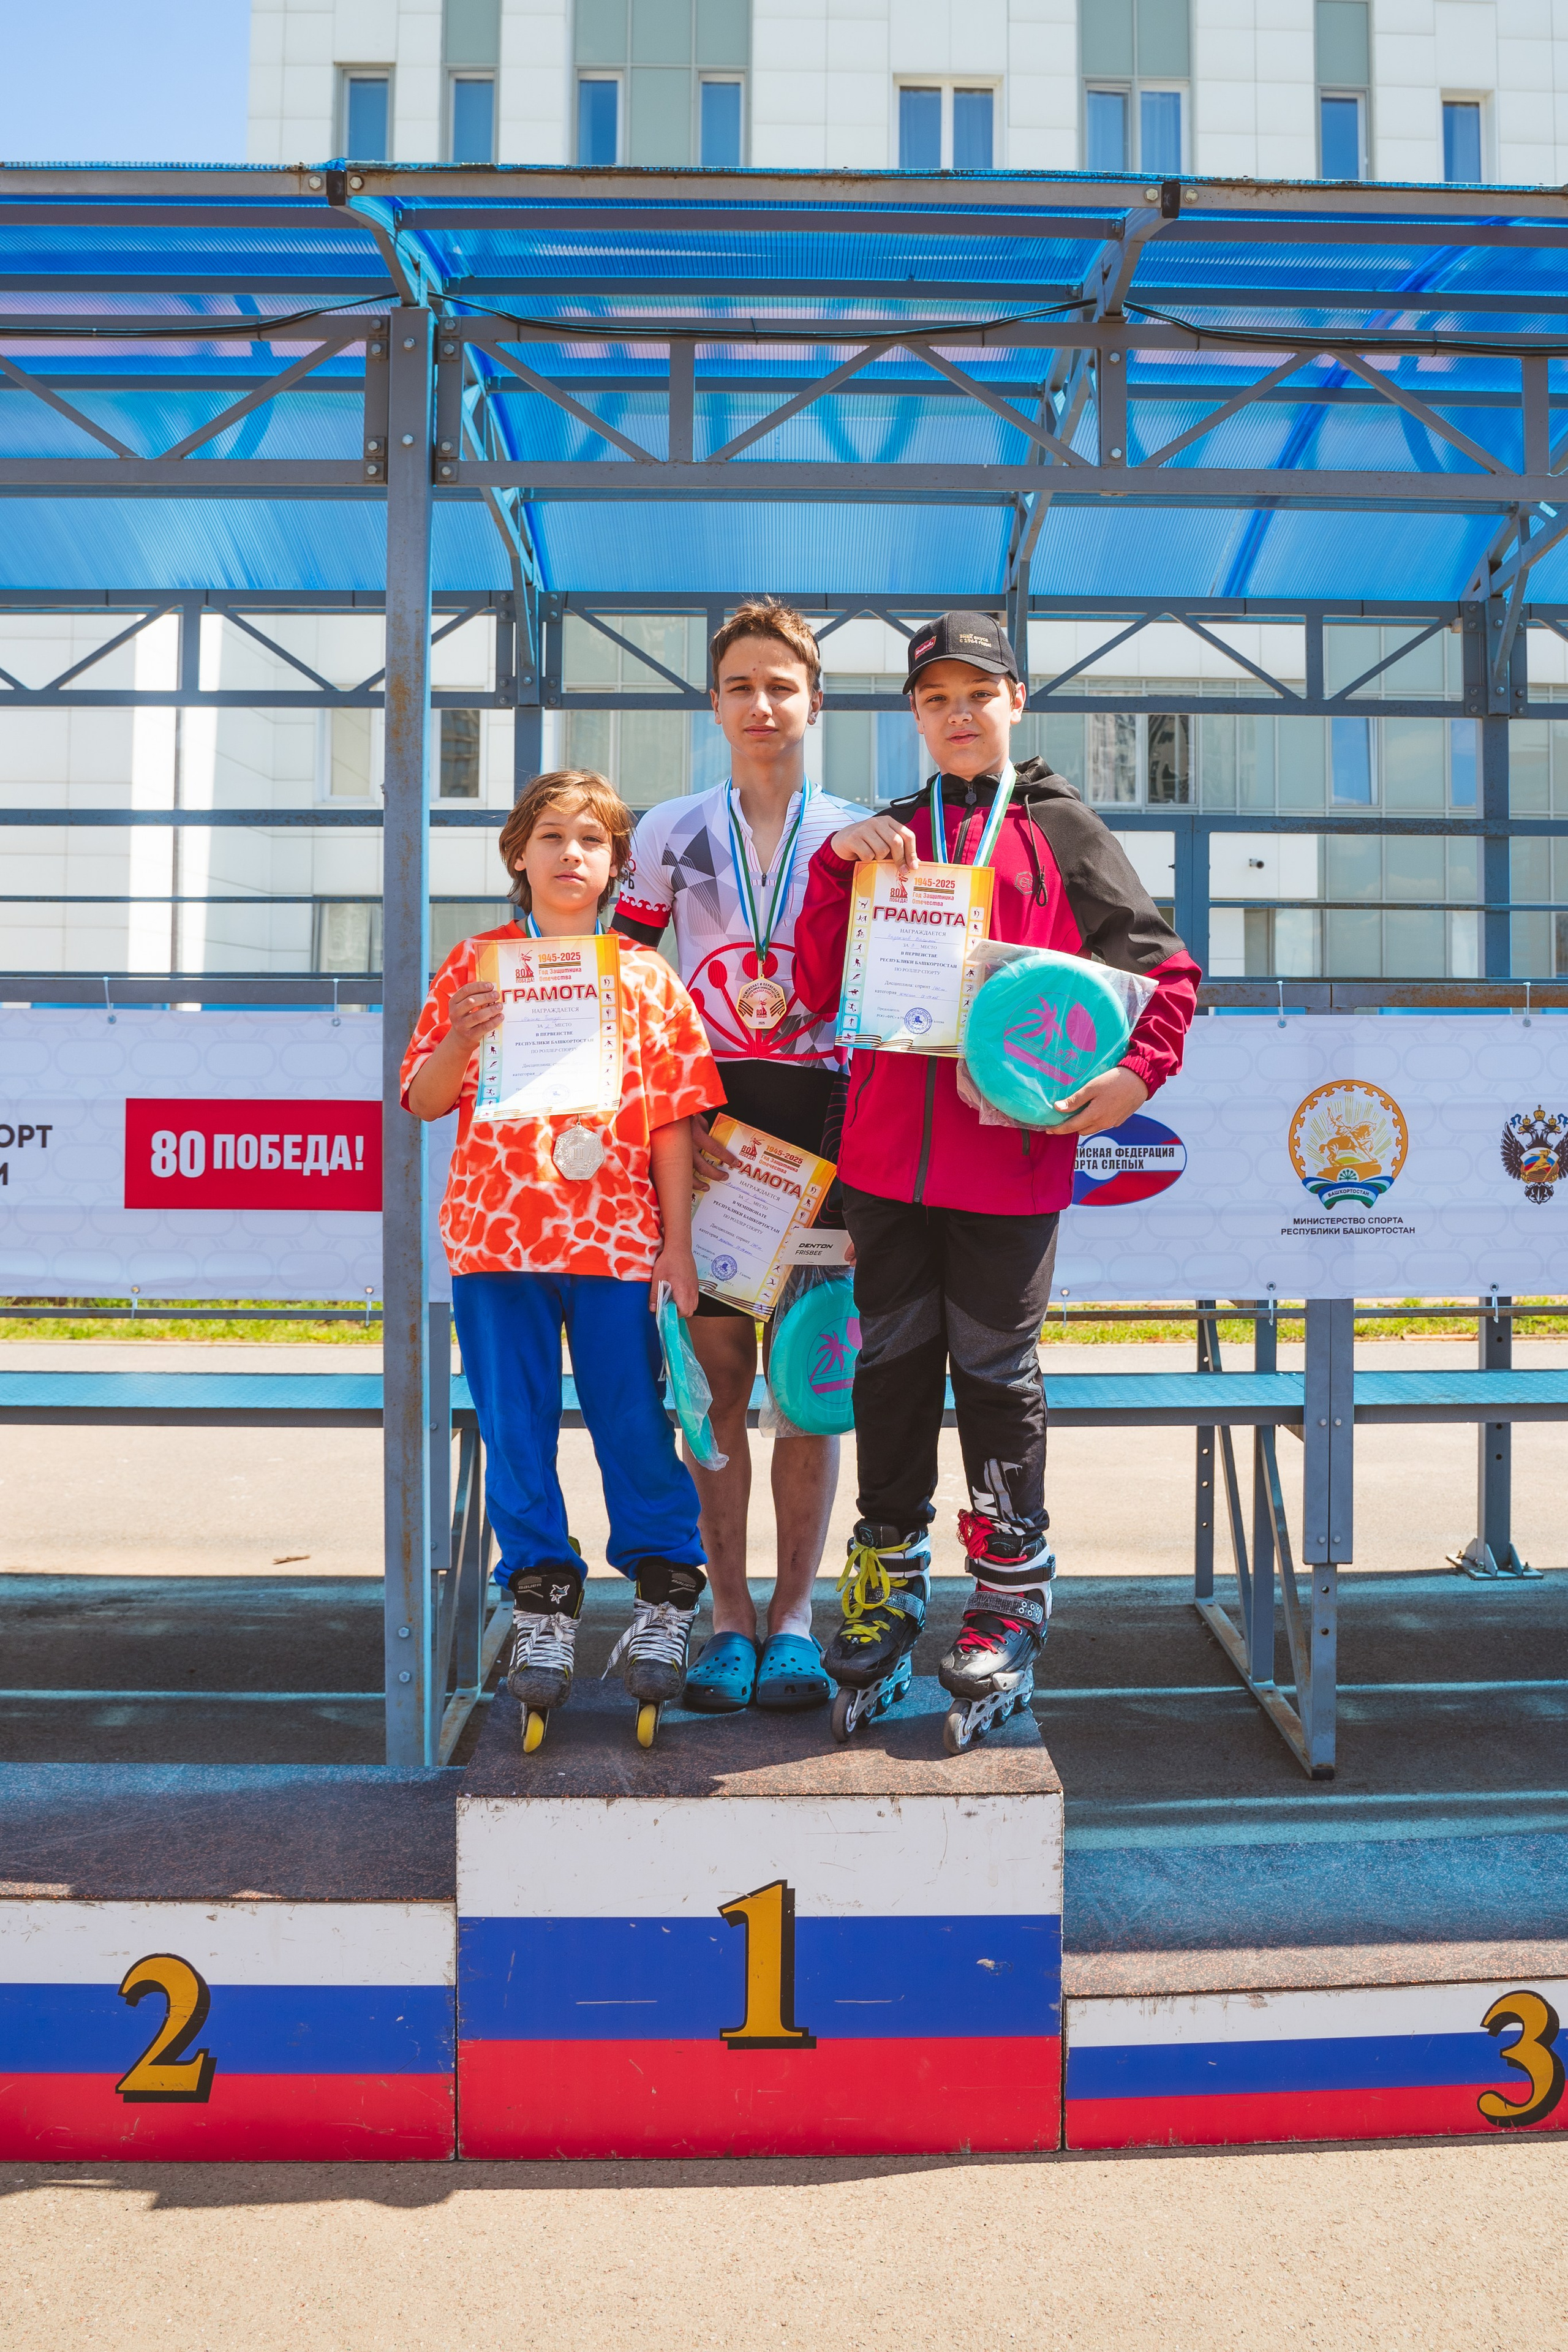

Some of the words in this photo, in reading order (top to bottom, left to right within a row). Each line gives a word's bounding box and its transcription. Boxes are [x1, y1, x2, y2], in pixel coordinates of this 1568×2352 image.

[914, 877, 956, 889] 1945-2025
[872, 905, 967, 928] ГРАМОТА
[538, 952, 581, 962] 1945-2025
[515, 969, 526, 978] 80
[500, 984, 599, 1004] ГРАМОТА
[151, 1130, 205, 1178] 80
[213, 1134, 364, 1176] ПОБЕДА!
[739, 1152, 755, 1161] ПОБЕДА!
[766, 1145, 804, 1164] 1945-2025
[1115, 1147, 1174, 1158] ФЕДЕРАЦИЯ
[759, 1159, 787, 1174] Отечества
[770, 1158, 798, 1173] Защитника
[1102, 1159, 1144, 1169] СЛЕПЫХ
[720, 1159, 802, 1199] РАМОТА
[739, 1180, 780, 1201] НАГРАЖДАЕТСЯ
[737, 1202, 767, 1219] ЧЕМПИОНАТЕ
[753, 1201, 768, 1210] МЕСТО
[713, 1200, 743, 1218] РЕСПУБЛИКИ
[744, 1214, 780, 1234] БАШКОРТОСТАН
[699, 1228, 718, 1239] категория
[730, 1217, 746, 1226] РОЛЛЕР
[746, 1224, 763, 1235] СПОРТУ
[671, 1579, 696, 1588] BAUER
[717, 1879, 816, 2049] 1
[115, 1953, 217, 2103] 2
[1477, 1989, 1565, 2128] 3
